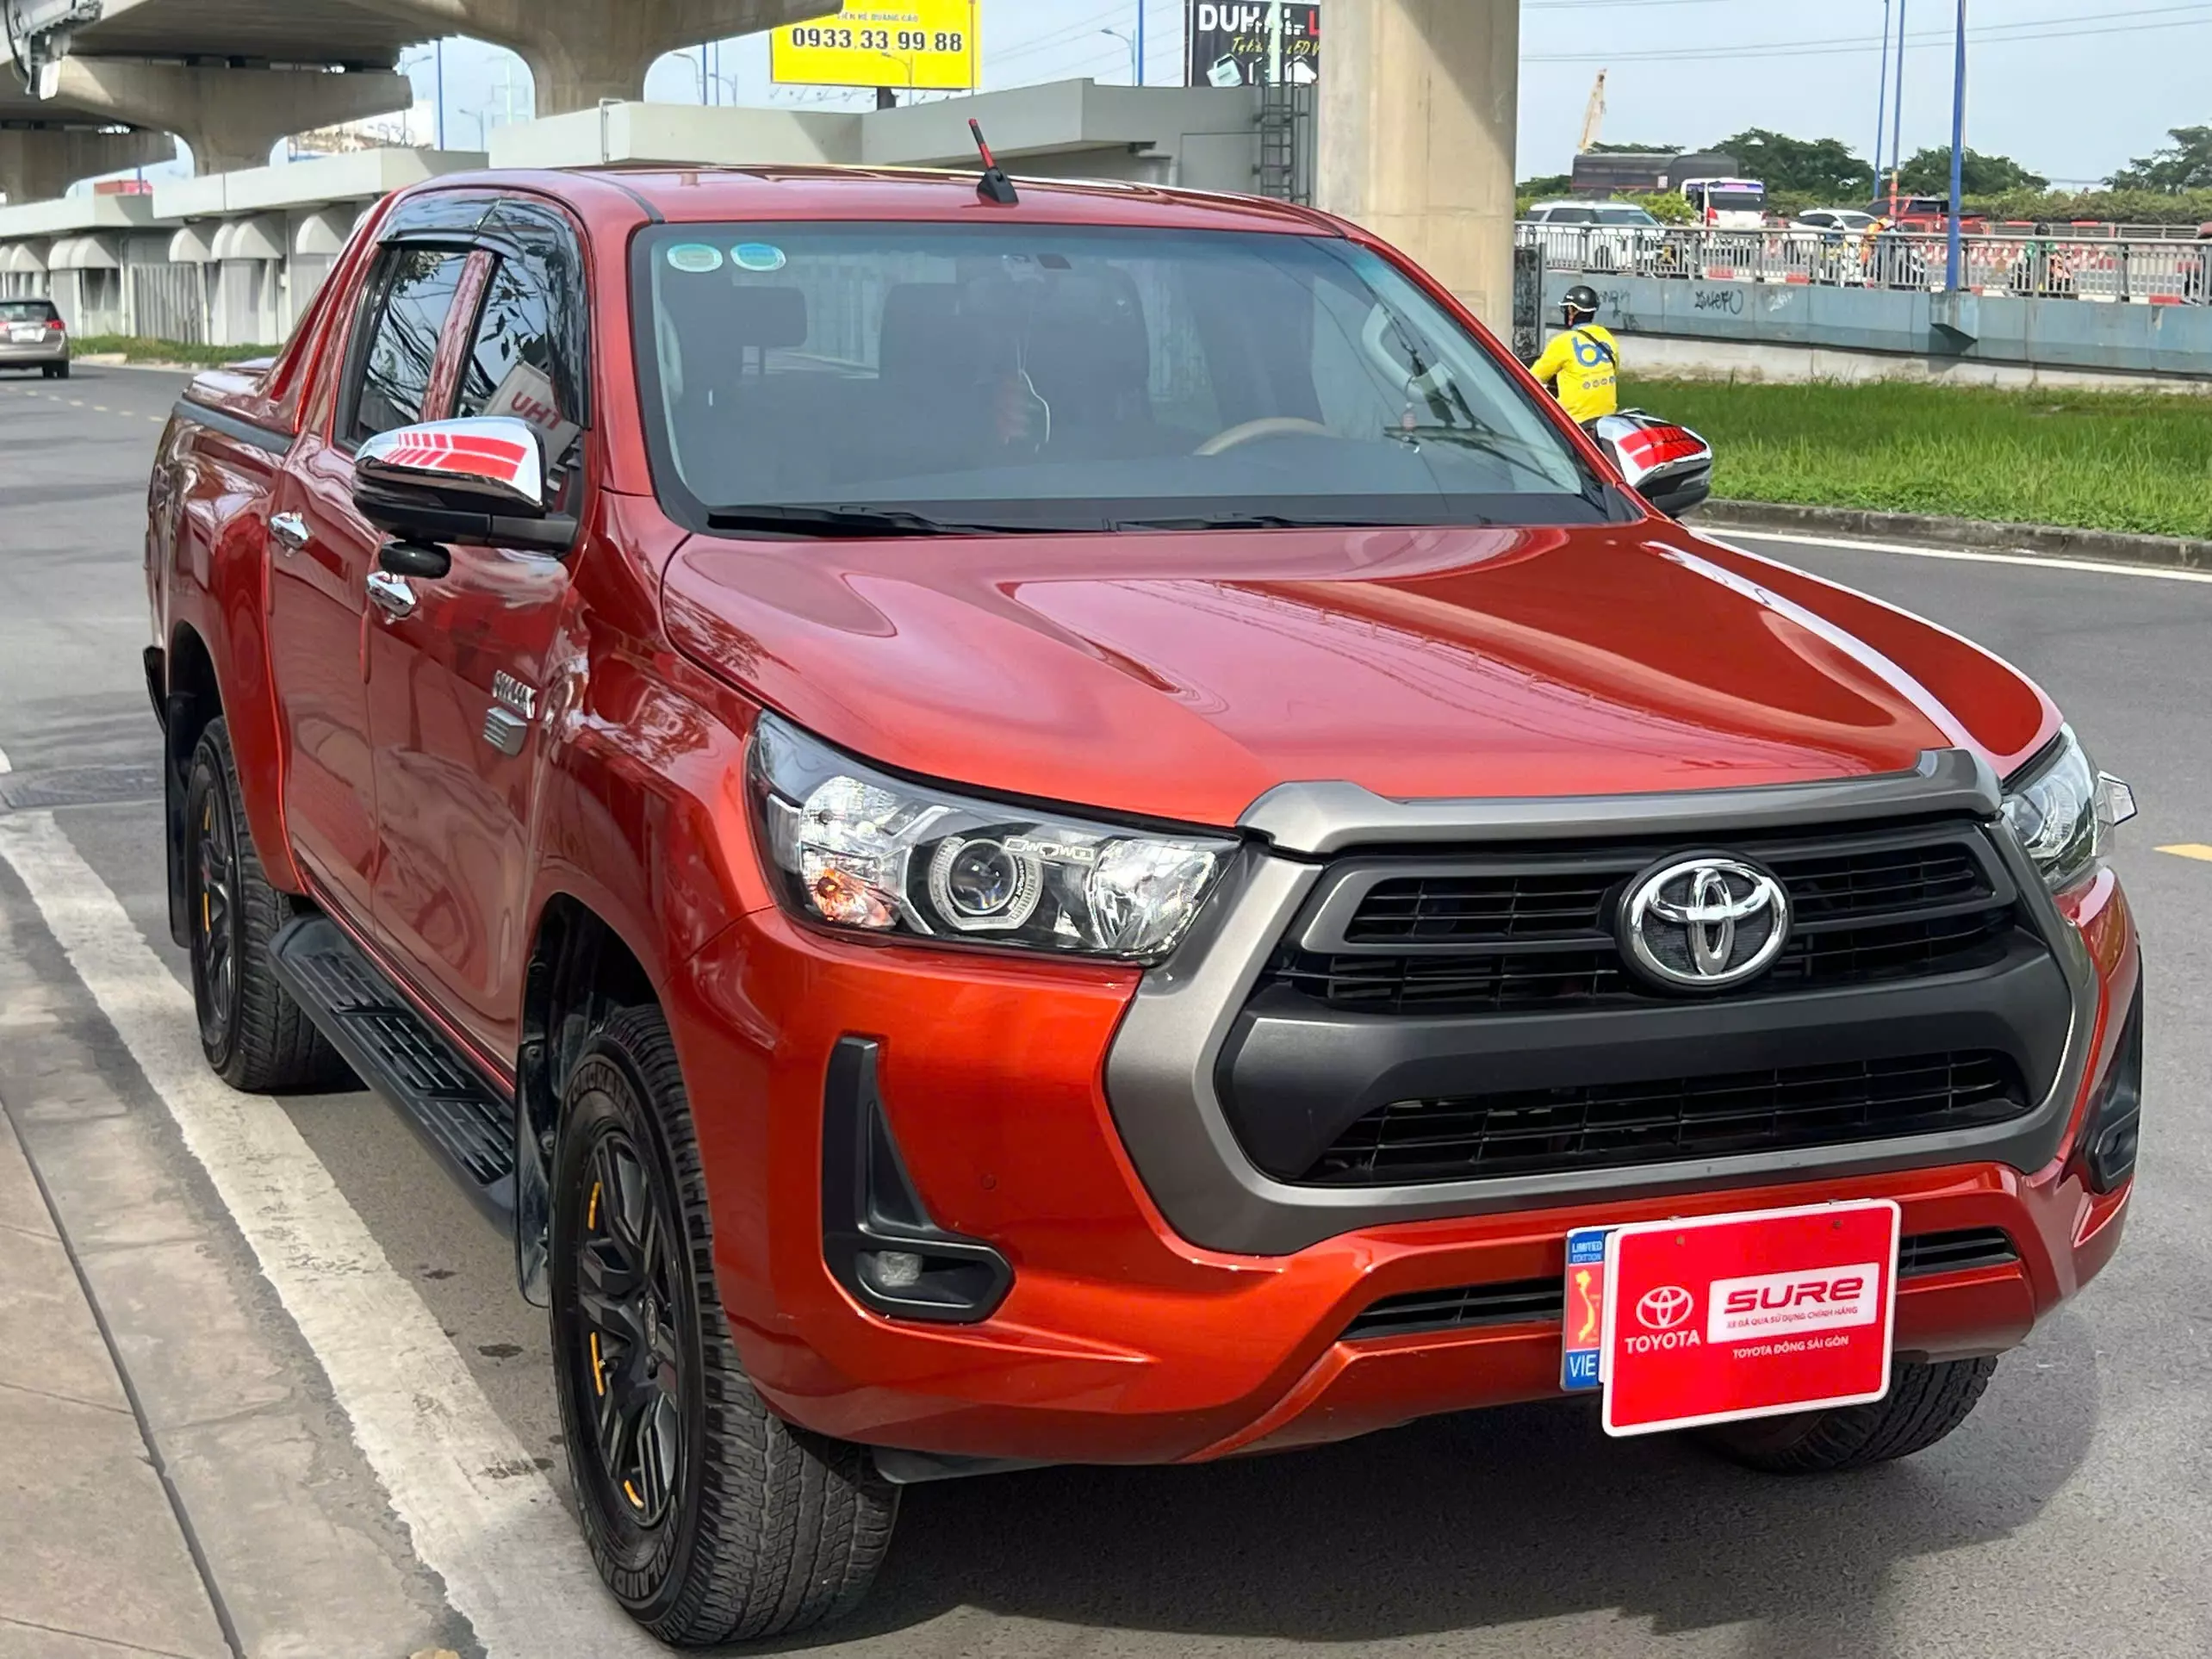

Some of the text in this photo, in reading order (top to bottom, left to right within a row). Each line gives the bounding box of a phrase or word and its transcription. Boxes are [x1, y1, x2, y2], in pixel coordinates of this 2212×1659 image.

[1198, 3, 1305, 35] DUHL
[1751, 1316, 1769, 1327] QUA
[1625, 1329, 1700, 1355] TOYOTA
[1733, 1344, 1772, 1360] TOYOTA
[1773, 1339, 1805, 1355] ĐÔNG
[1569, 1354, 1597, 1377] VIE
